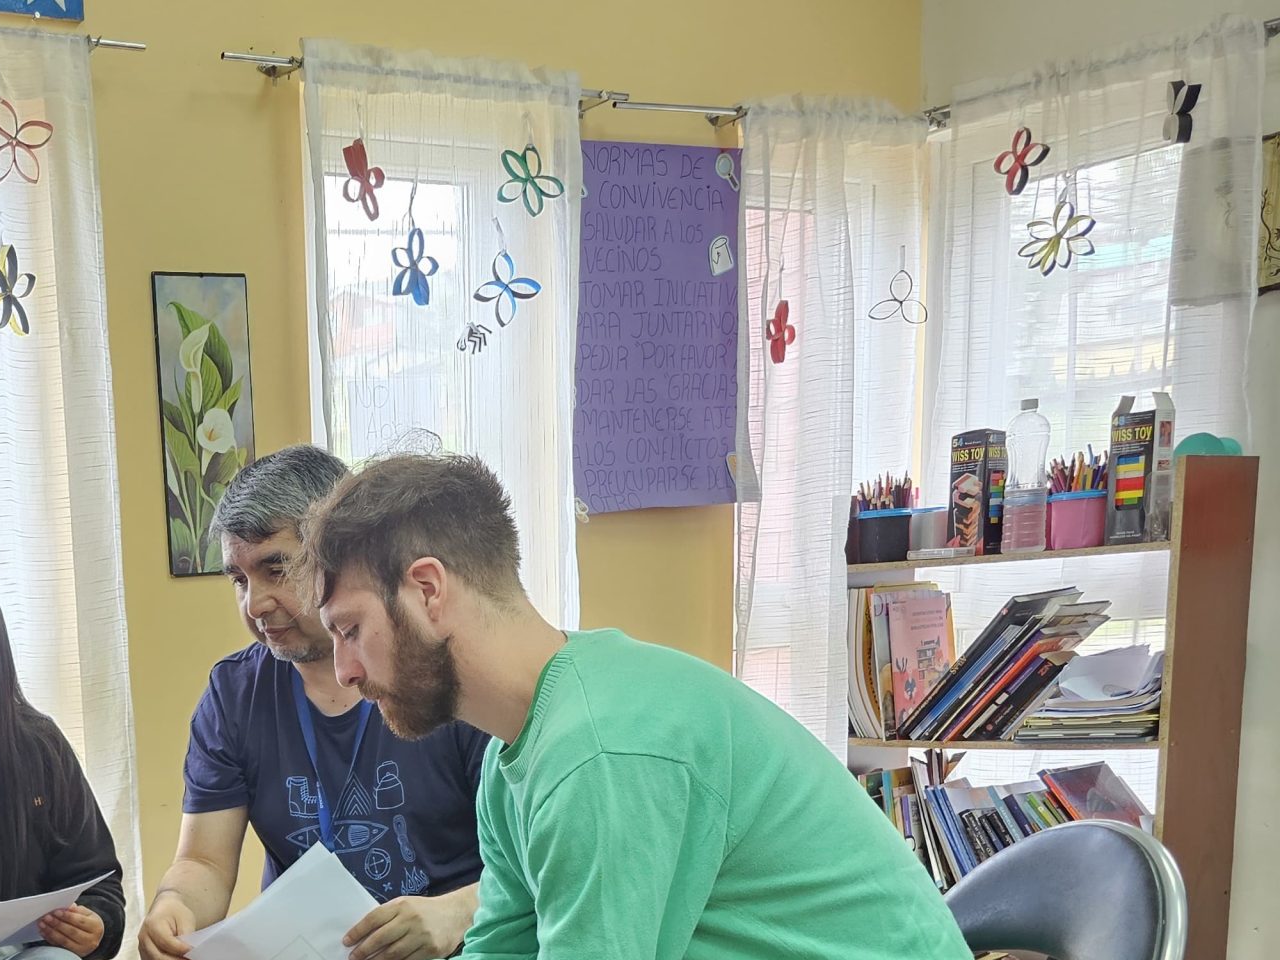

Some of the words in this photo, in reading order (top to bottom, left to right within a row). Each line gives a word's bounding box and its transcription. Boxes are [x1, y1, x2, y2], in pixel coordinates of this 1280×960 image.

[680, 153, 705, 180] DE
[583, 211, 657, 245] SALUDAR
[663, 218, 675, 245] A
[679, 220, 704, 245] LOS
[583, 244, 663, 274] VECINOS
[579, 279, 646, 309] TOMAR
[579, 378, 615, 406] DAR
[625, 377, 658, 404] LAS
[703, 405, 738, 432] AJE
[1134, 426, 1153, 441] TOY
[585, 440, 616, 467] LOS
[970, 447, 985, 461] TOY
